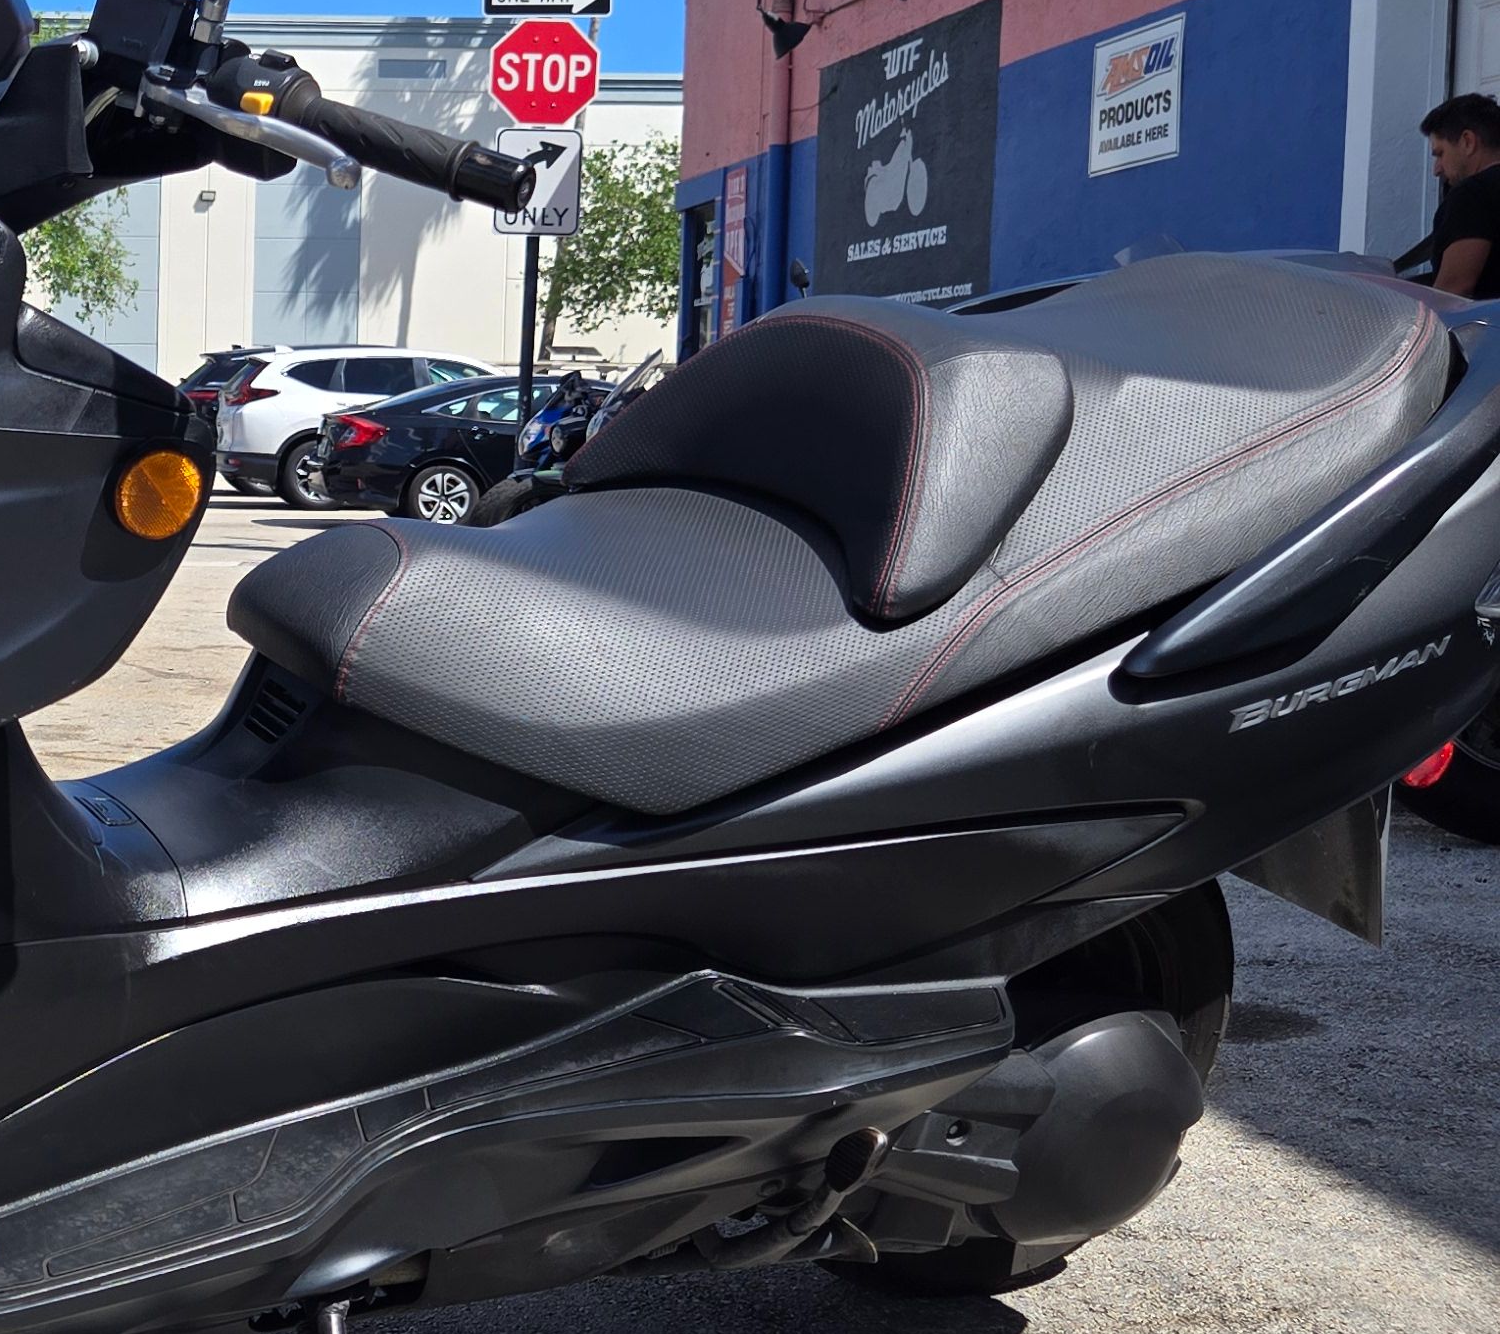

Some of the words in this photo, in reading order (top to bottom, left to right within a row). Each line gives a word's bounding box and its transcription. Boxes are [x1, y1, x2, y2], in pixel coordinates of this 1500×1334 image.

[497, 52, 592, 93] STOP
[882, 38, 924, 80] WTF
[1101, 37, 1176, 96] AMSOIL
[855, 49, 949, 149] Motorcycles
[1099, 89, 1172, 131] PRODUCTS
[1098, 130, 1142, 155] AVAILABLE
[1144, 123, 1170, 142] HERE
[504, 207, 569, 227] ONLY
[846, 238, 881, 263] SALES
[881, 237, 892, 256] &
[892, 225, 947, 254] SERVICE
[1228, 635, 1453, 734] BURGMAN
